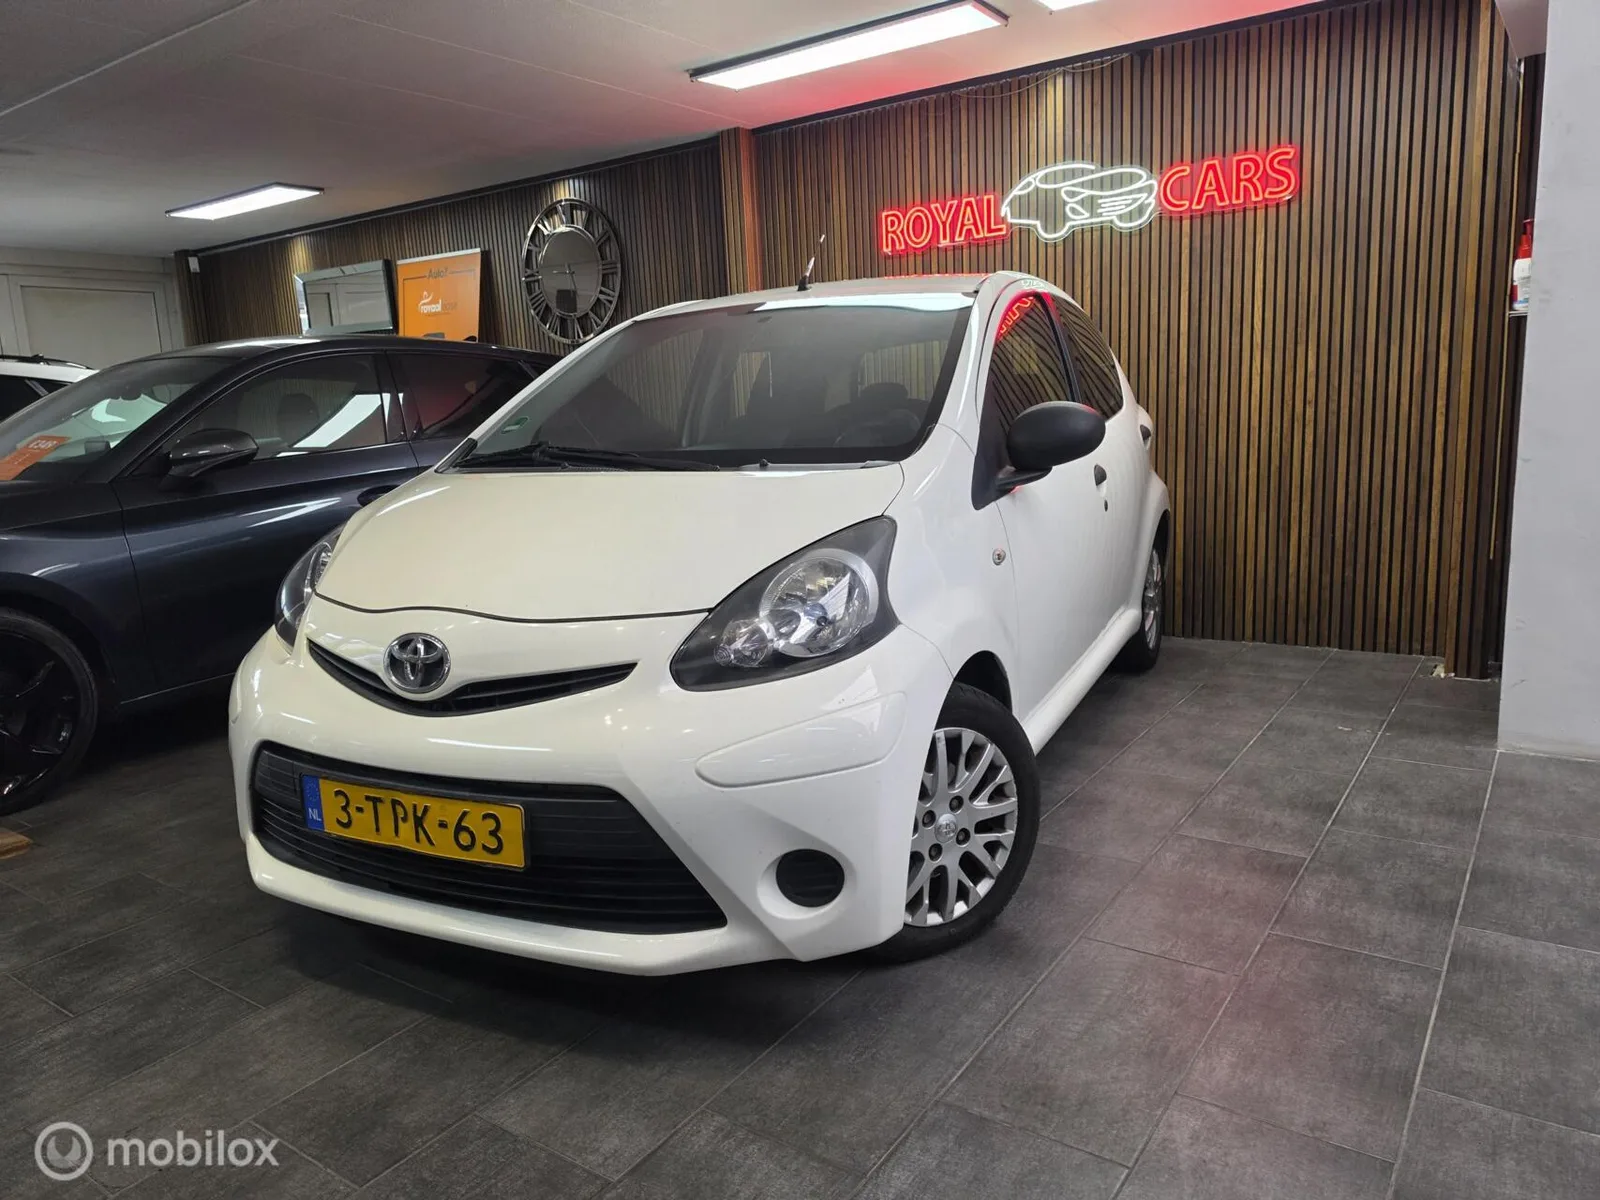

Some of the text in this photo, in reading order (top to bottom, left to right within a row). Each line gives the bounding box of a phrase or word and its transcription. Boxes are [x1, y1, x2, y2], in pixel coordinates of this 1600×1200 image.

[881, 146, 1298, 253] ROYAL CARS
[308, 808, 322, 821] NL
[333, 788, 503, 855] 3-TPK-63
